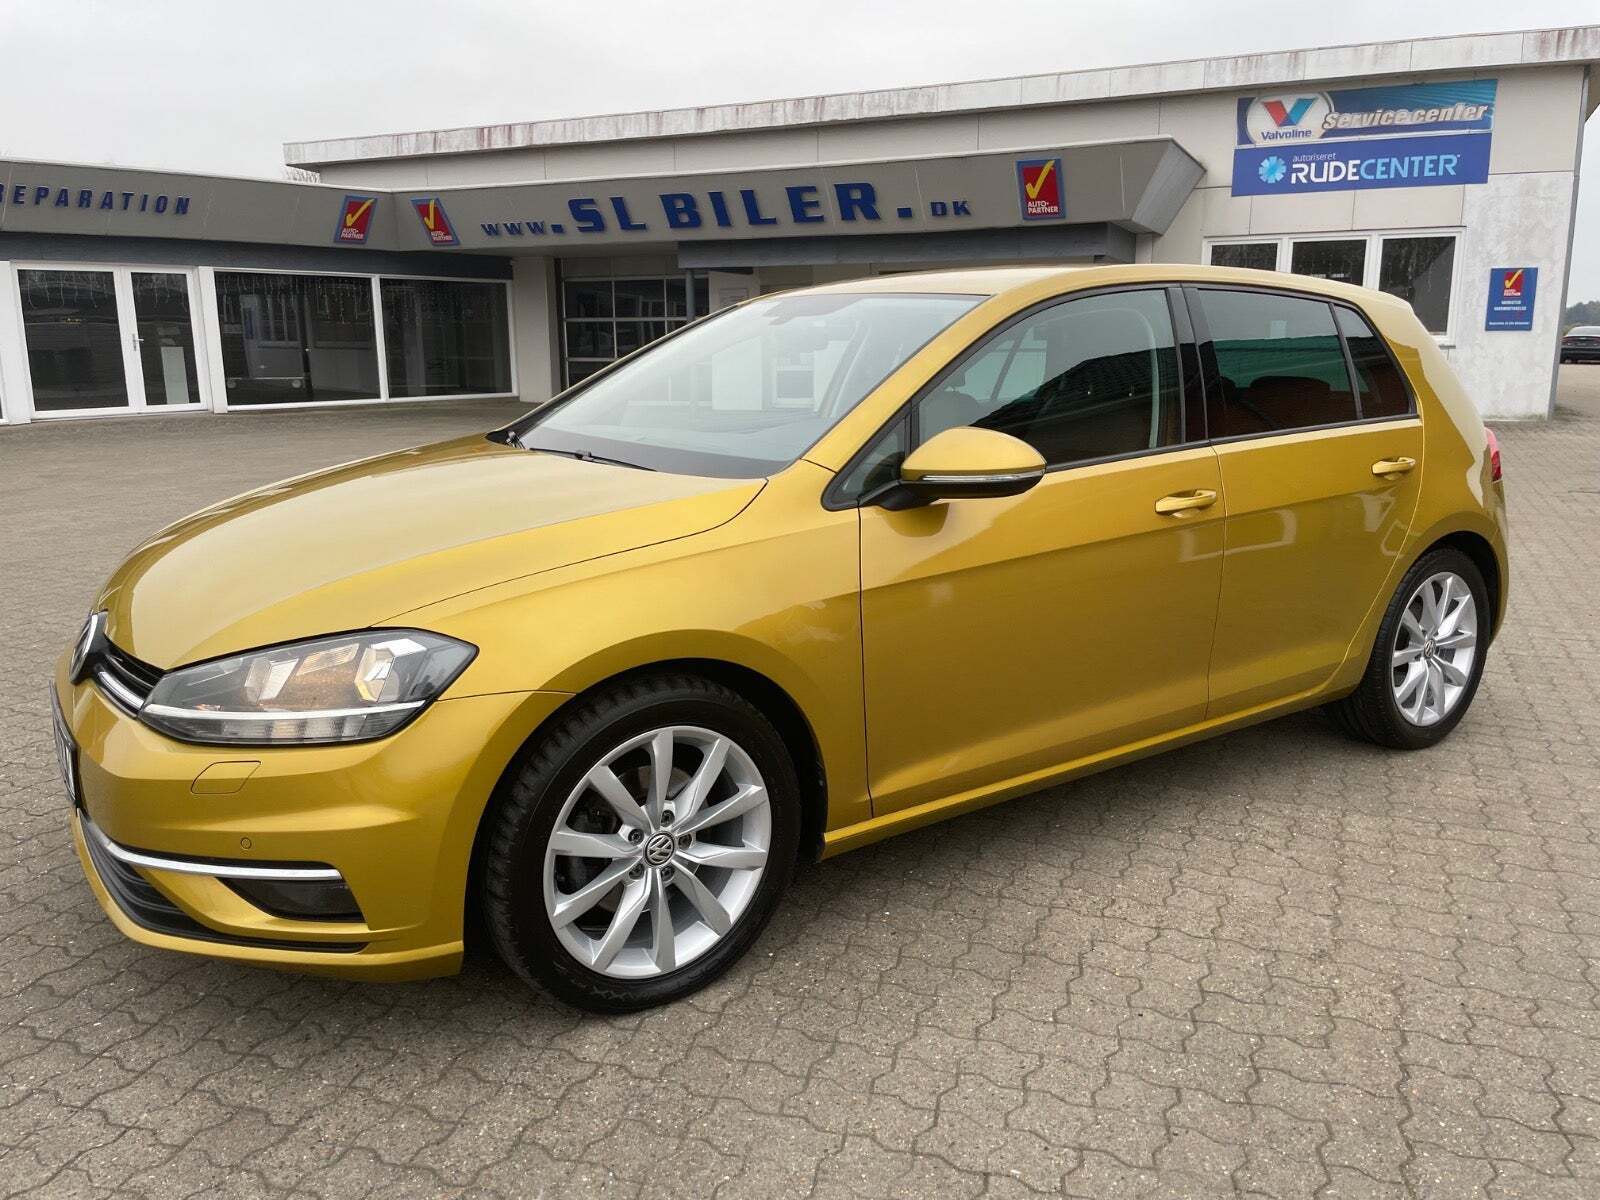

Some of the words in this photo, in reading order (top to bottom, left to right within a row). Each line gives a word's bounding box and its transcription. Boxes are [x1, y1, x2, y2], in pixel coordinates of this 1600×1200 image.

[1261, 129, 1312, 141] Valvoline
[1292, 152, 1336, 162] autoriseret
[0, 182, 192, 215] EPARATION
[1028, 206, 1058, 214] PARTNER
